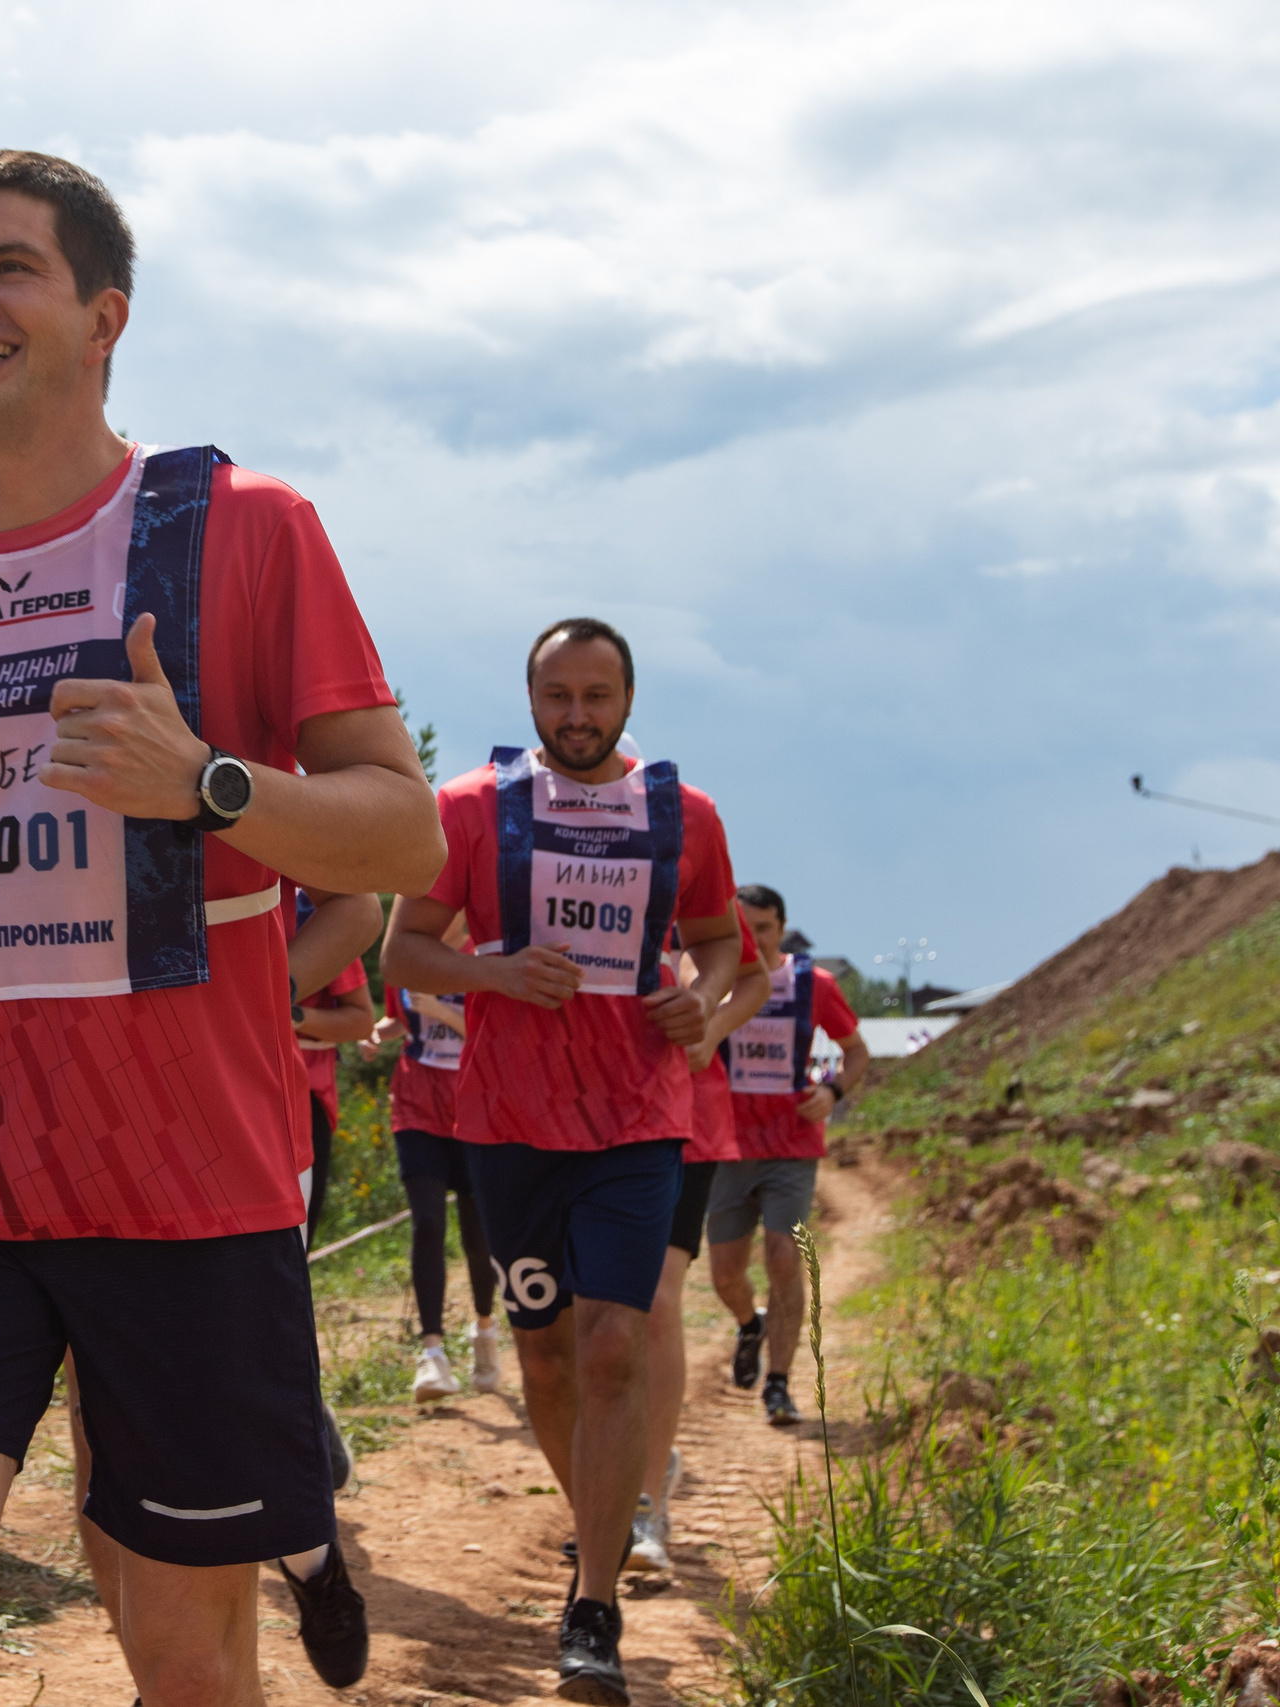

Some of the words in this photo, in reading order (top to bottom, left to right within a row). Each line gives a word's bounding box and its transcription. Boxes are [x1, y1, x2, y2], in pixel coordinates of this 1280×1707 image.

[10, 589, 91, 617] ГЕРОЕВ
[549, 799, 586, 809] ГОНКА
[554, 827, 630, 843] КОМАНДНЫЙ
[573, 841, 609, 856] СТАРТ
[546, 897, 633, 934] 15009
